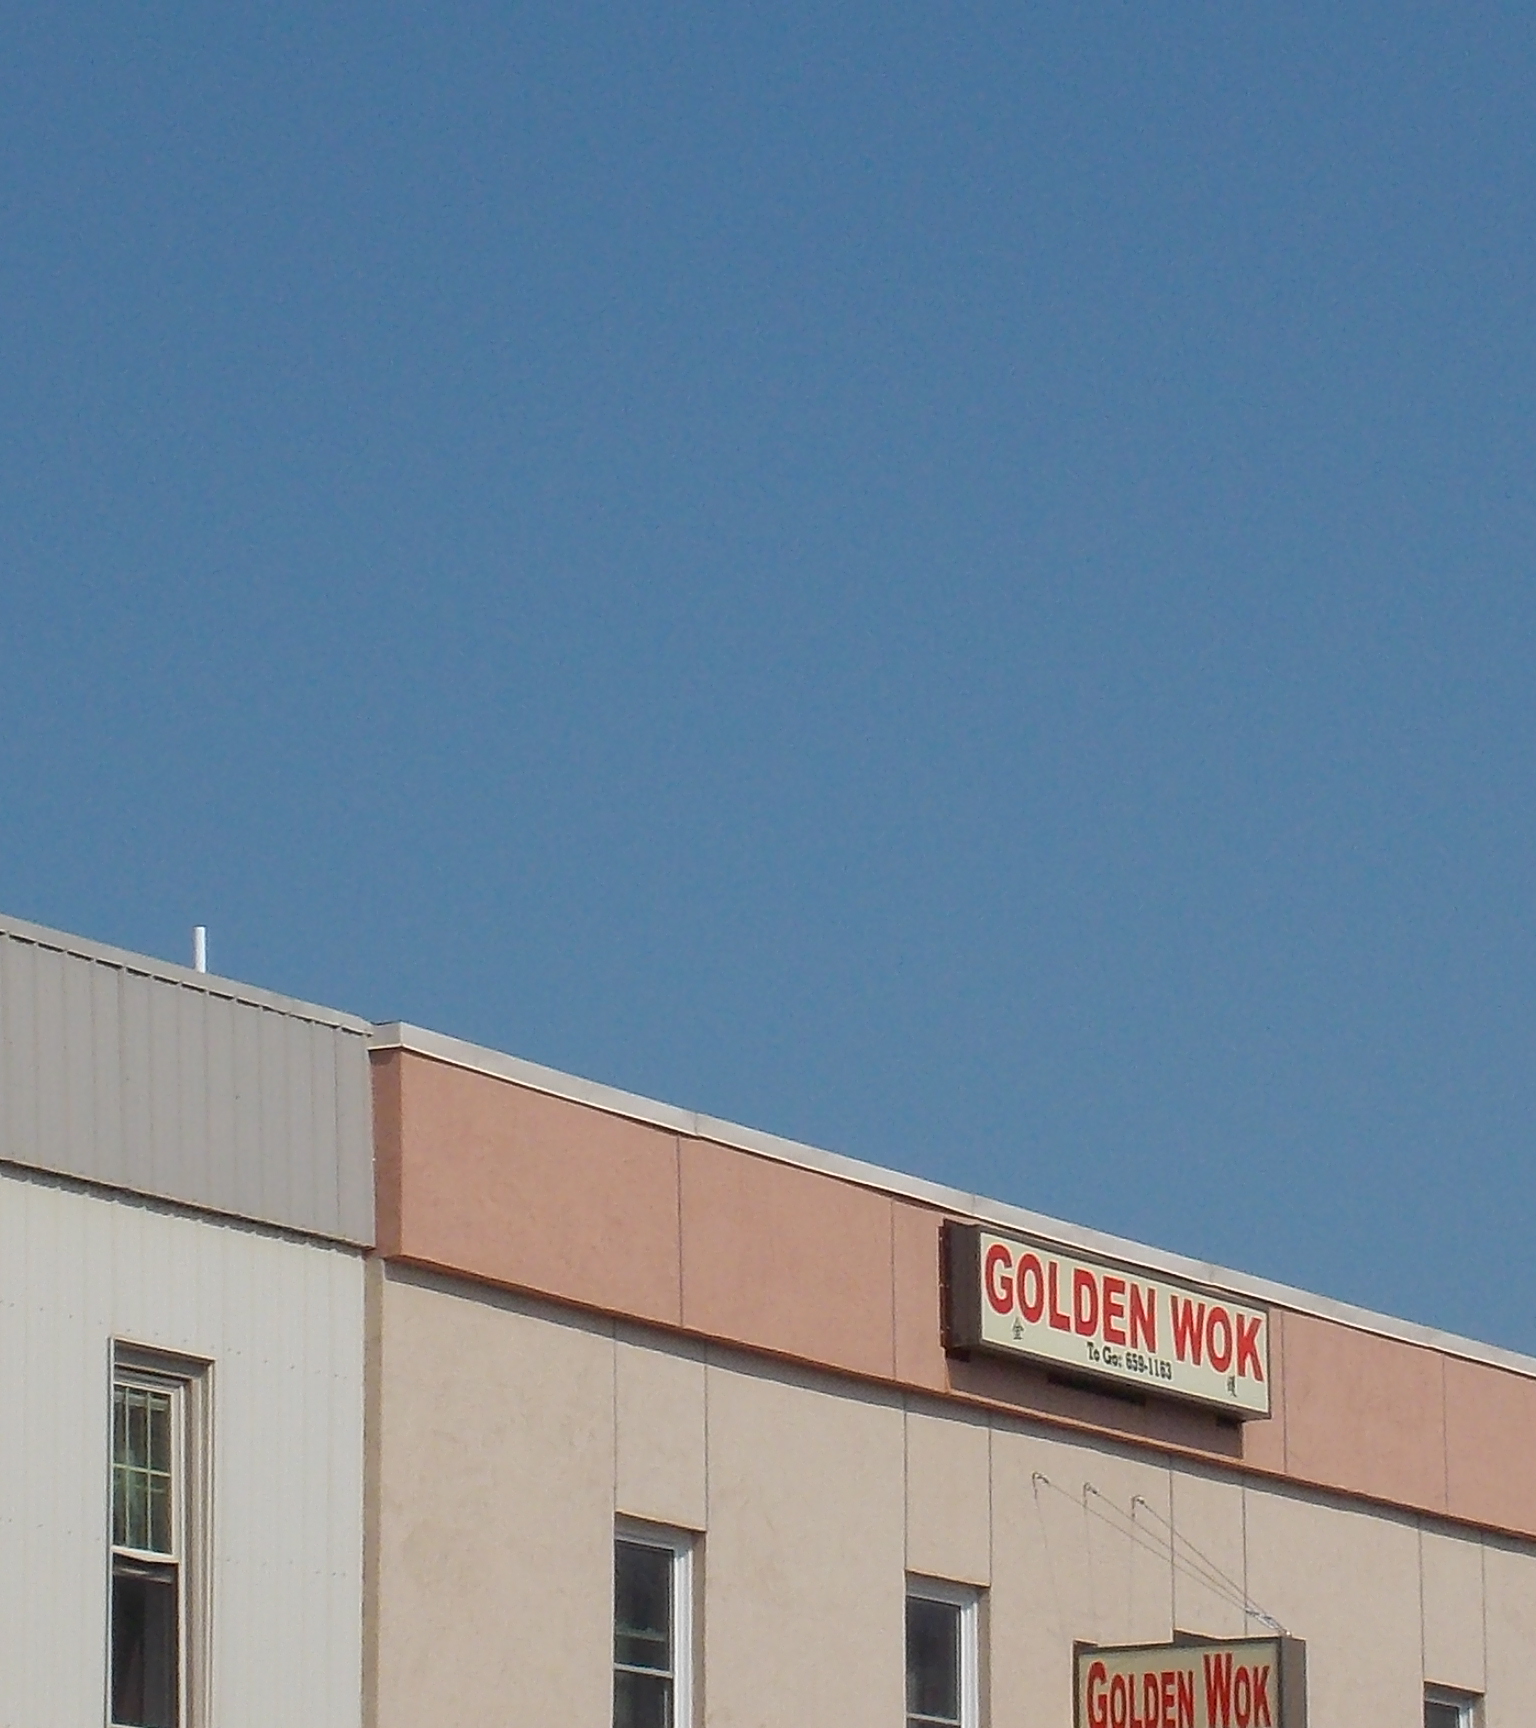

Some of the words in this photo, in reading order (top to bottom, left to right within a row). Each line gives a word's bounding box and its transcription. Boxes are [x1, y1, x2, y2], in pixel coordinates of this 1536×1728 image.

[985, 1244, 1157, 1353] GOLDEN
[1171, 1295, 1263, 1381] WOK
[1087, 1342, 1100, 1360] To
[1126, 1352, 1172, 1380] 659-1163
